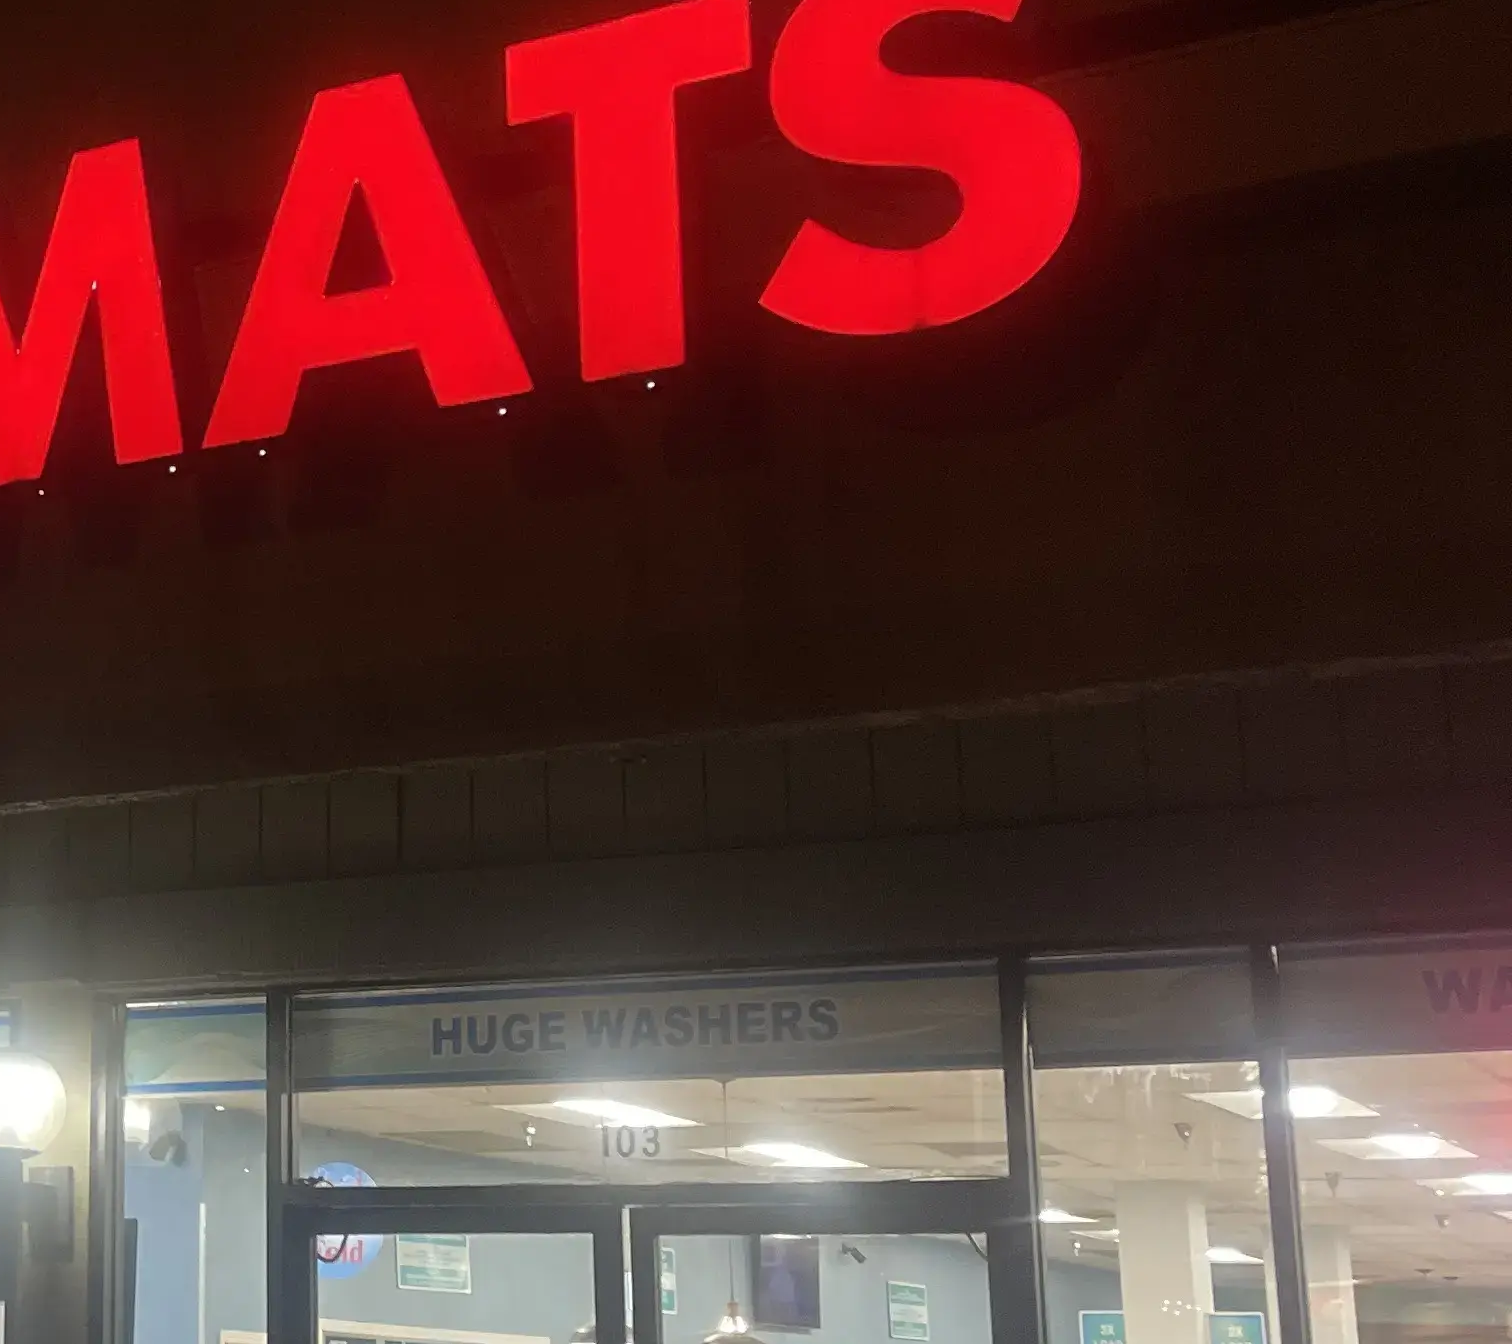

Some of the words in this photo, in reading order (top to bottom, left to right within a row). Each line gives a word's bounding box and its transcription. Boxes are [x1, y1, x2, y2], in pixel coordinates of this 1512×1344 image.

[432, 1011, 566, 1056] HUGE
[582, 999, 839, 1049] WASHERS
[602, 1125, 661, 1157] 103
